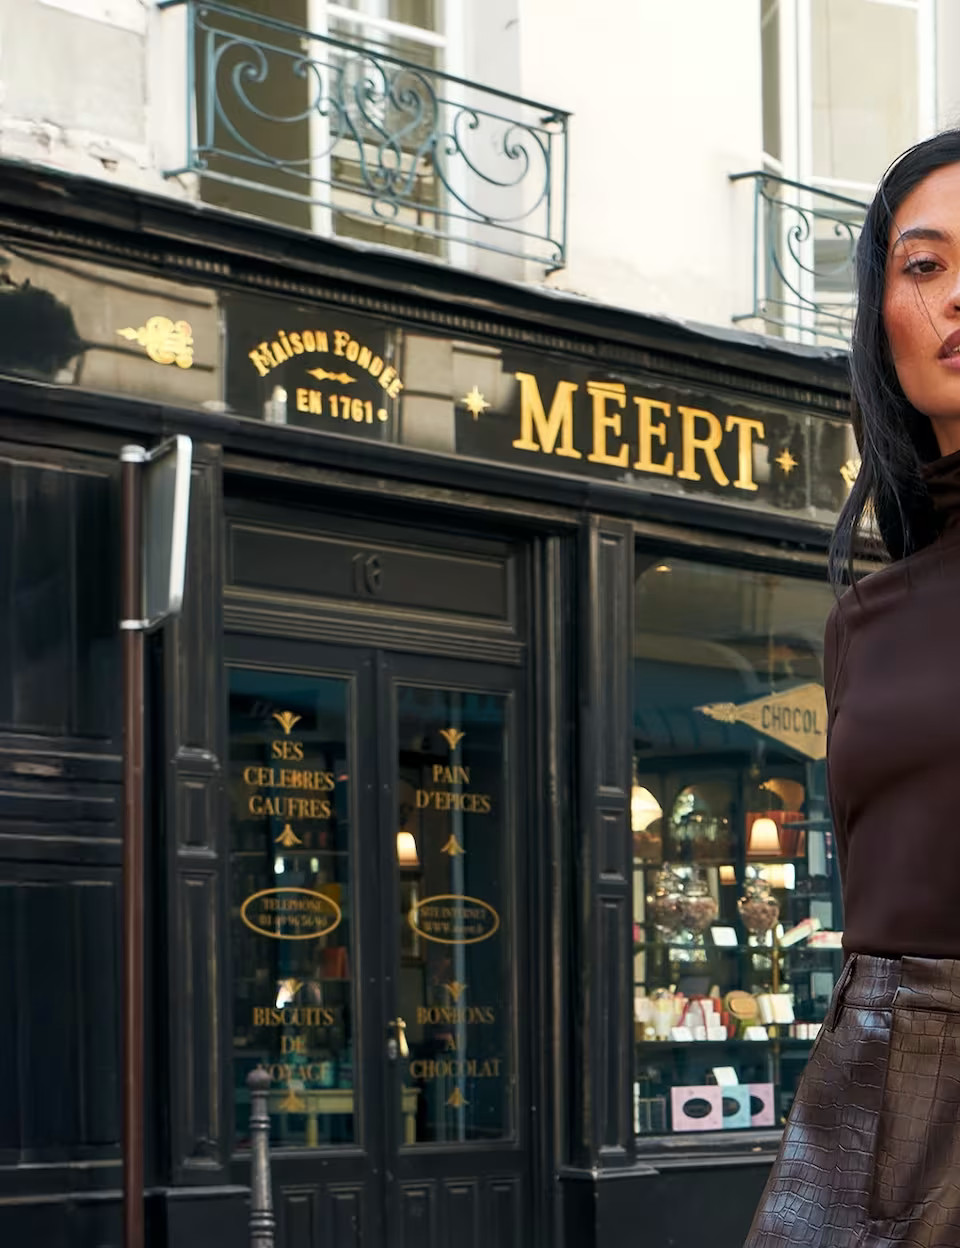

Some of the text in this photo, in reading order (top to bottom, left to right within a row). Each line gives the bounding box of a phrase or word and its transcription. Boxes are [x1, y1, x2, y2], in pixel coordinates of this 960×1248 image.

[296, 387, 373, 424] EN 1761
[271, 740, 304, 760] SES
[432, 763, 470, 784] PAIN
[248, 795, 332, 819] GAUFRES
[252, 1007, 335, 1027] BISCUITS
[280, 1034, 307, 1054] DE
